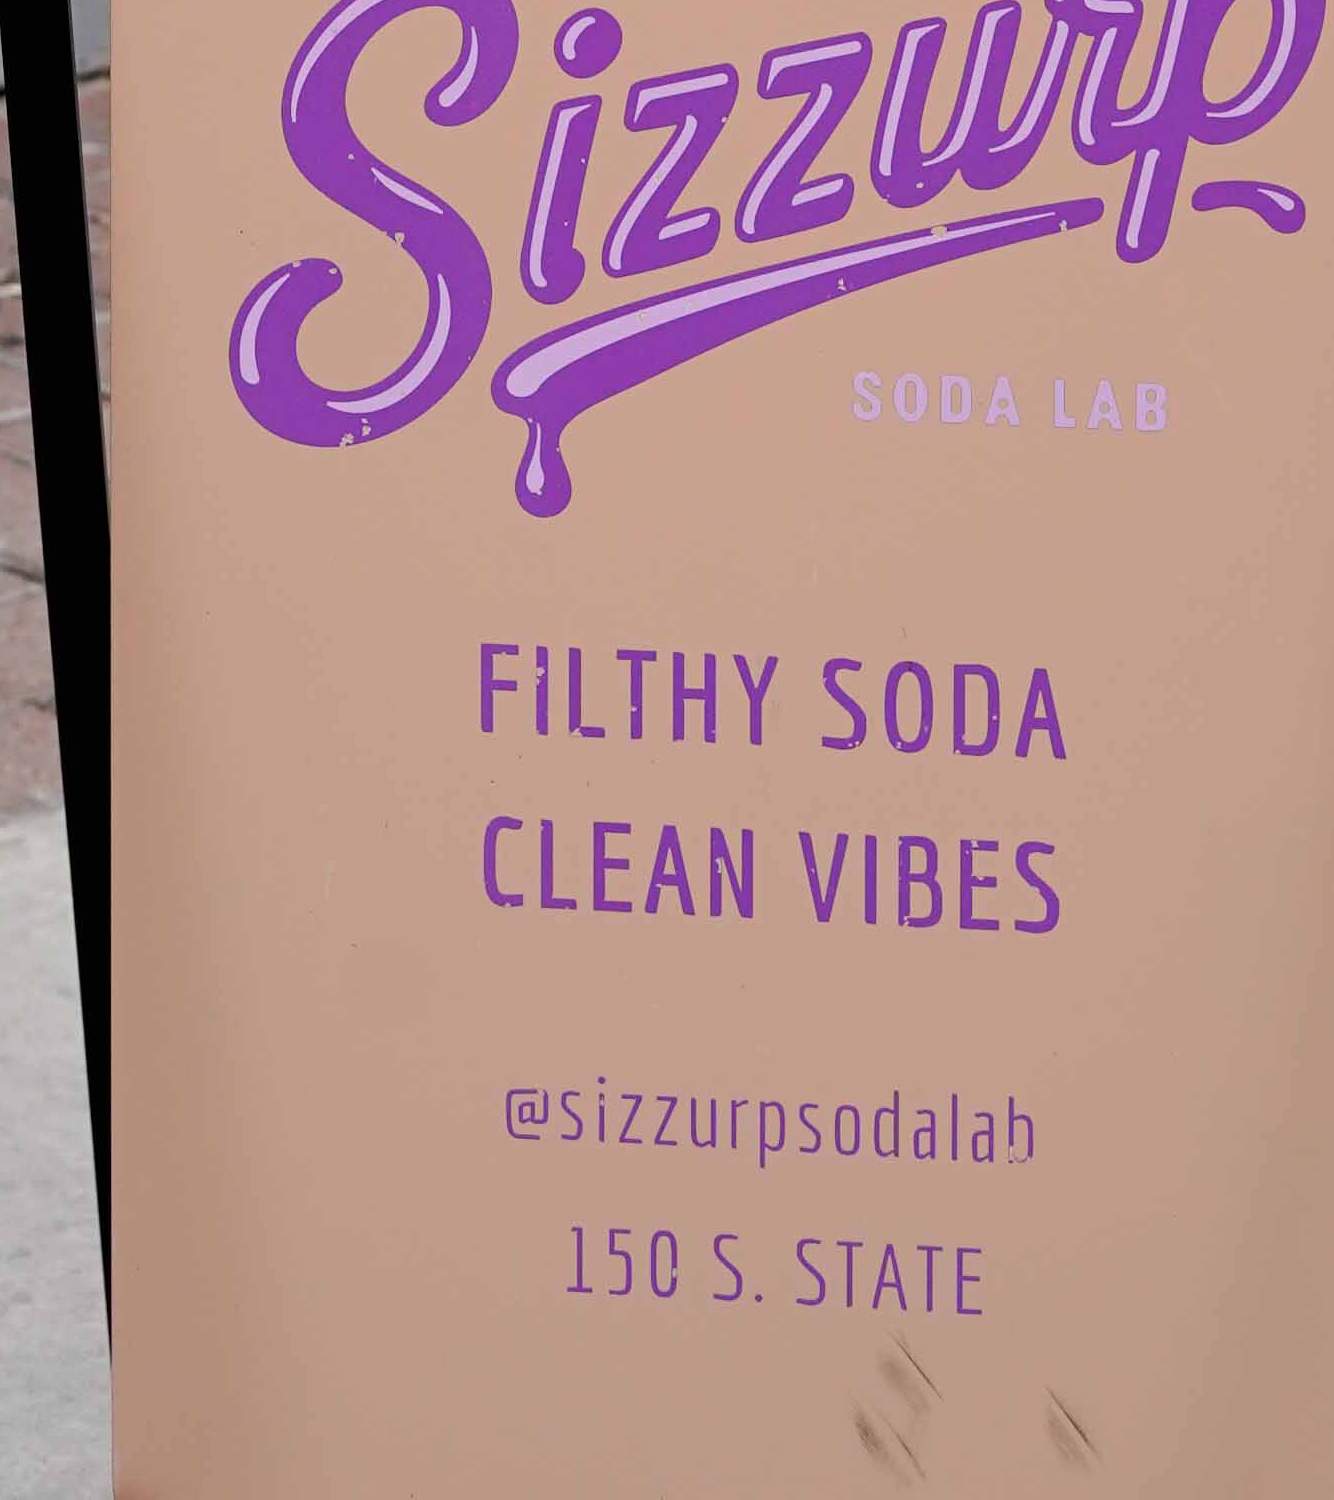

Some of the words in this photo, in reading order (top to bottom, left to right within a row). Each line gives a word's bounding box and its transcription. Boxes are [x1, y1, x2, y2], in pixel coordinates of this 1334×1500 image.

[852, 369, 1023, 428] SODA
[1053, 375, 1170, 433] LAB
[480, 643, 778, 745] FILTHY
[821, 656, 1067, 759] SODA
[482, 815, 756, 920] CLEAN
[798, 831, 1061, 934] VIBES
[505, 1076, 1037, 1168] @sizzurpsodalab
[565, 1226, 679, 1300] 150
[713, 1233, 769, 1305] S.
[795, 1238, 985, 1316] STATE
